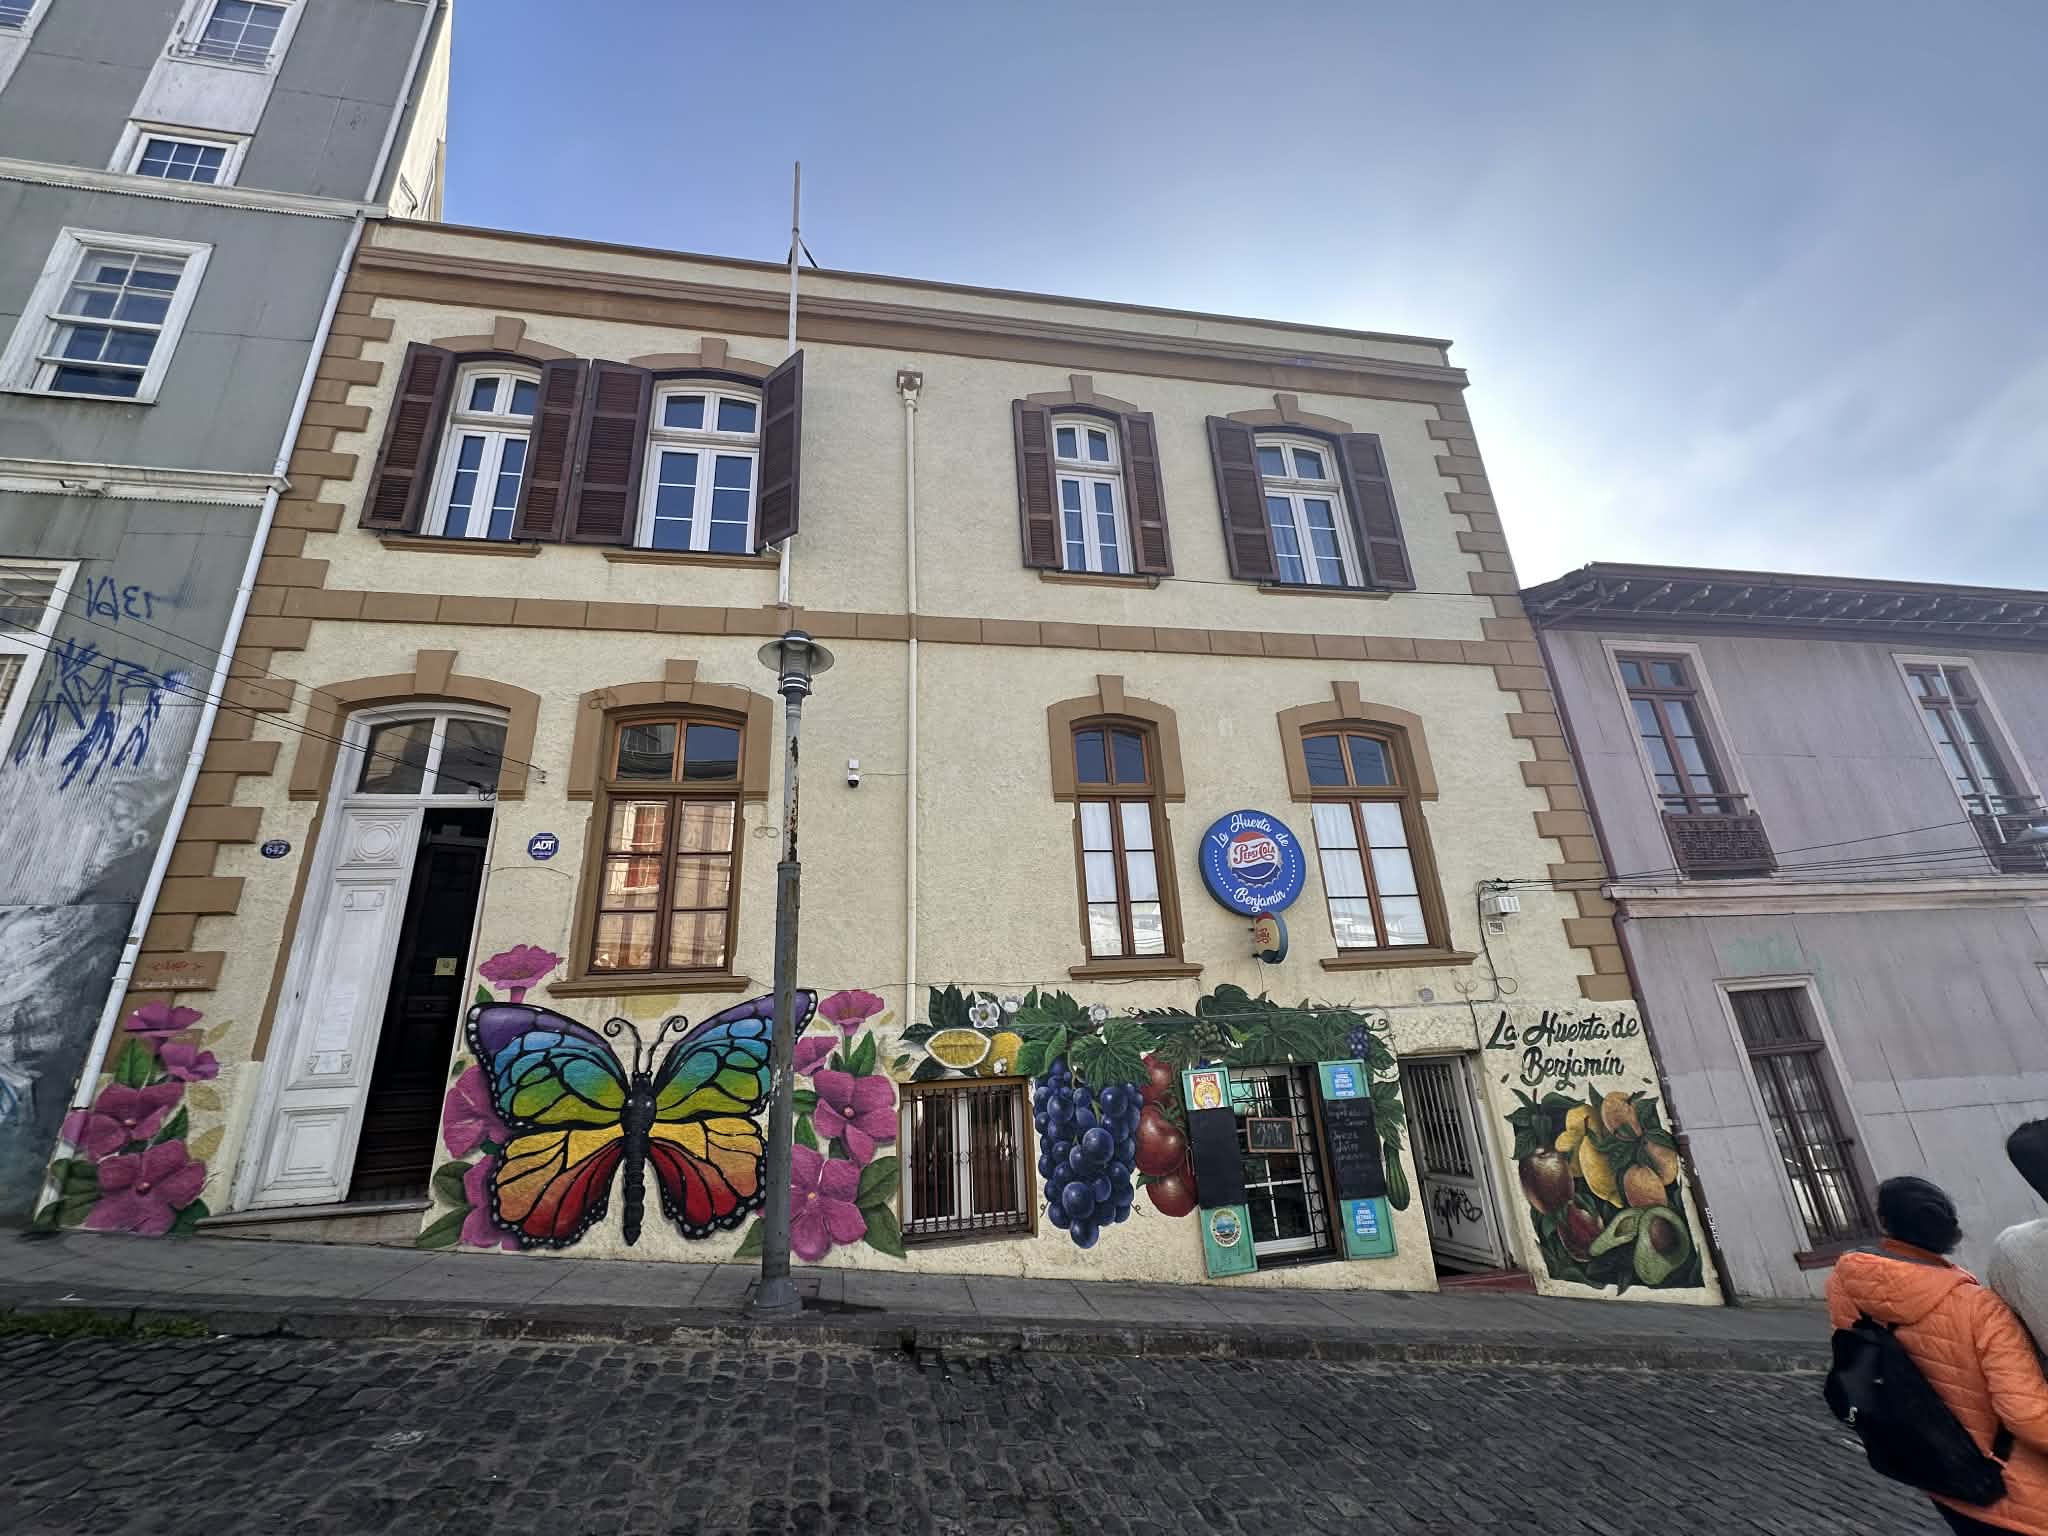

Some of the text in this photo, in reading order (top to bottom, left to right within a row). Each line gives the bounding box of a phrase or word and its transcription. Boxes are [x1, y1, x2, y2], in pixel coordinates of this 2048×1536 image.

[532, 840, 556, 850] ADT
[1211, 813, 1289, 849] La Huerta de
[1486, 1010, 1640, 1050] La Huerta de
[1520, 1046, 1624, 1091] Benjamín
